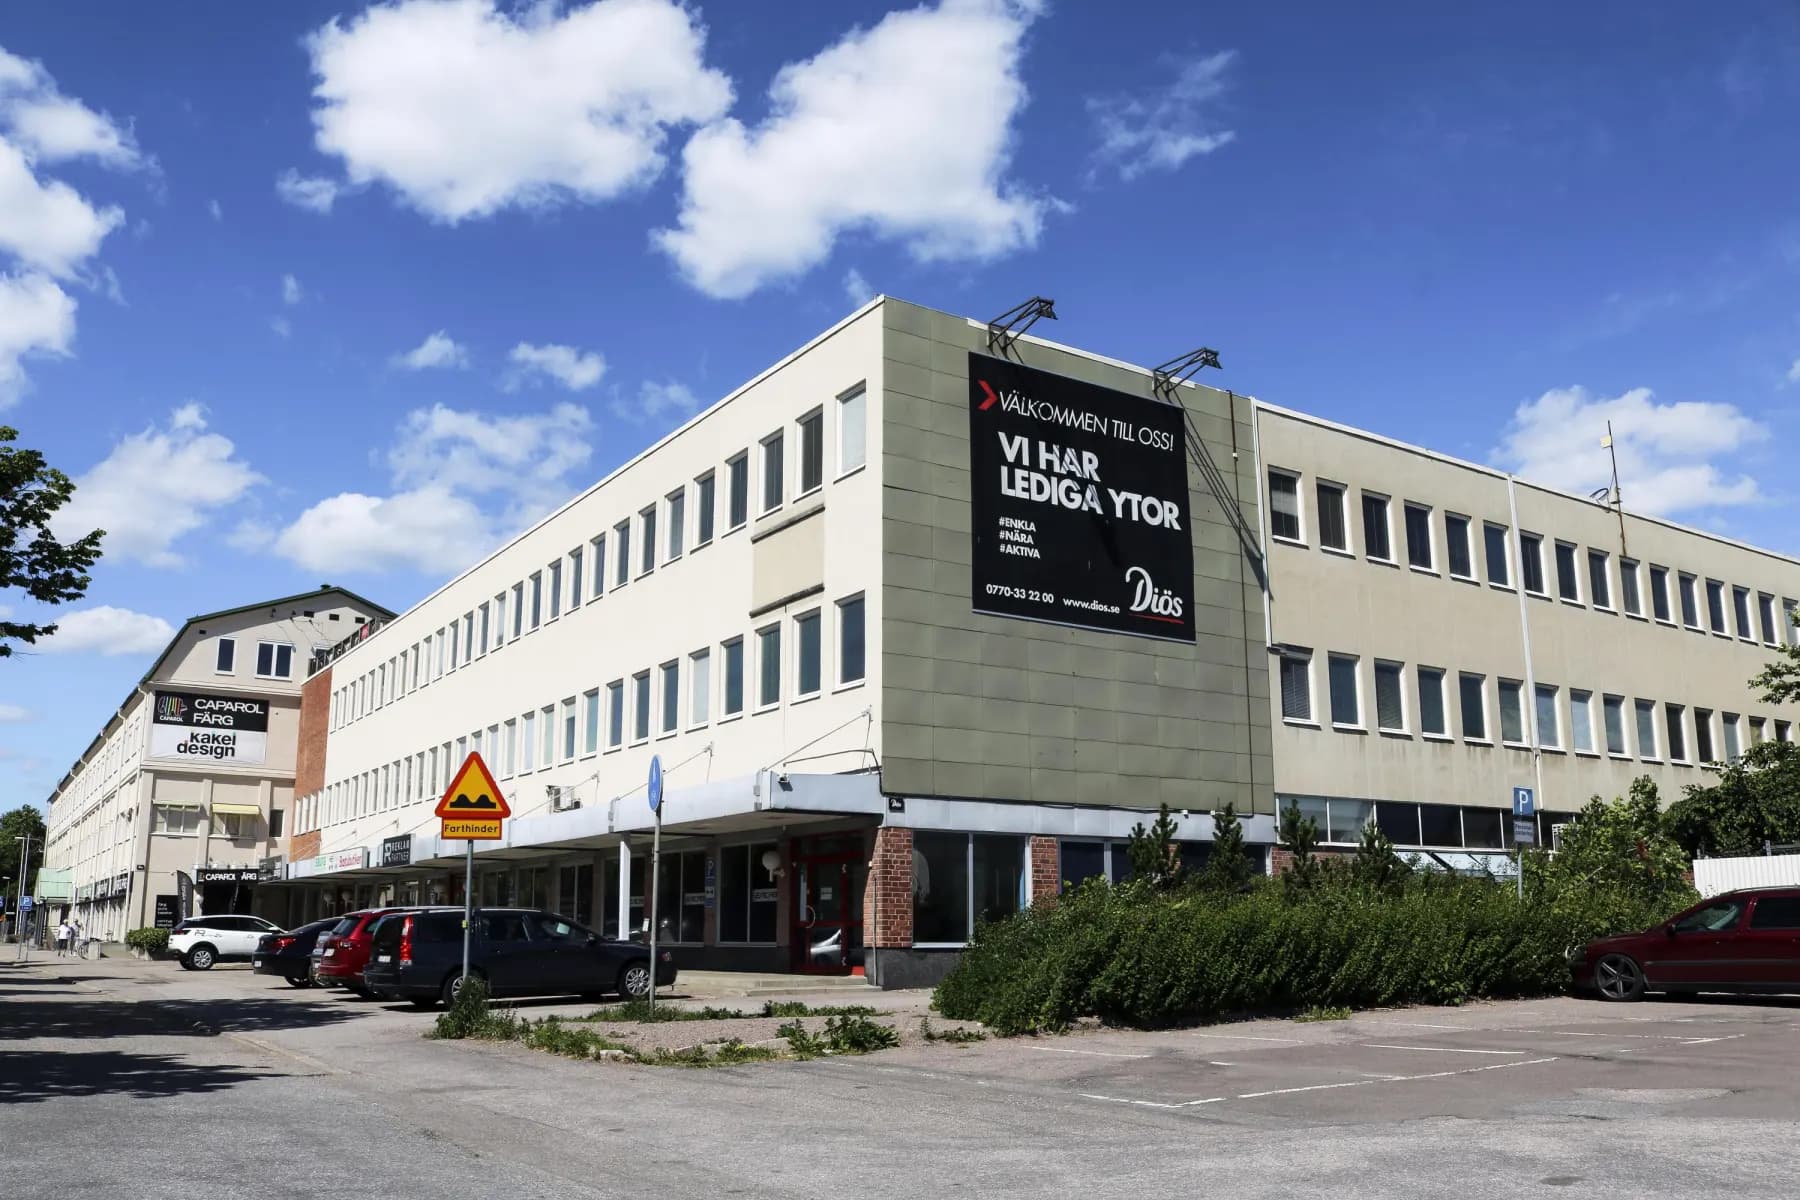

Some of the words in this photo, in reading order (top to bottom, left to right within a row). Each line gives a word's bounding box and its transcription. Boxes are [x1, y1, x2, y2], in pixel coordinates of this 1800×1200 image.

[999, 390, 1108, 435] VÄLKOMMEN
[1112, 419, 1135, 442] TILL
[1138, 427, 1174, 451] OSS!
[998, 432, 1030, 466] VI
[1039, 440, 1101, 482] HAR
[1000, 466, 1104, 514] LEDIGA
[1107, 488, 1182, 530] YTOR
[999, 517, 1036, 532] #ENKLA
[999, 530, 1034, 544] #NÄRA
[999, 543, 1041, 559] #AKTIVA
[986, 583, 1026, 600] 0770-33
[1028, 589, 1041, 602] 22
[1042, 592, 1054, 604] 00
[1125, 566, 1183, 617] Diös
[1062, 597, 1121, 614] www.dios.se
[194, 698, 264, 714] CAPAROL
[193, 712, 234, 726] FÄRG
[190, 731, 236, 746] kakel
[176, 740, 235, 759] design
[444, 823, 499, 833] Farthinder
